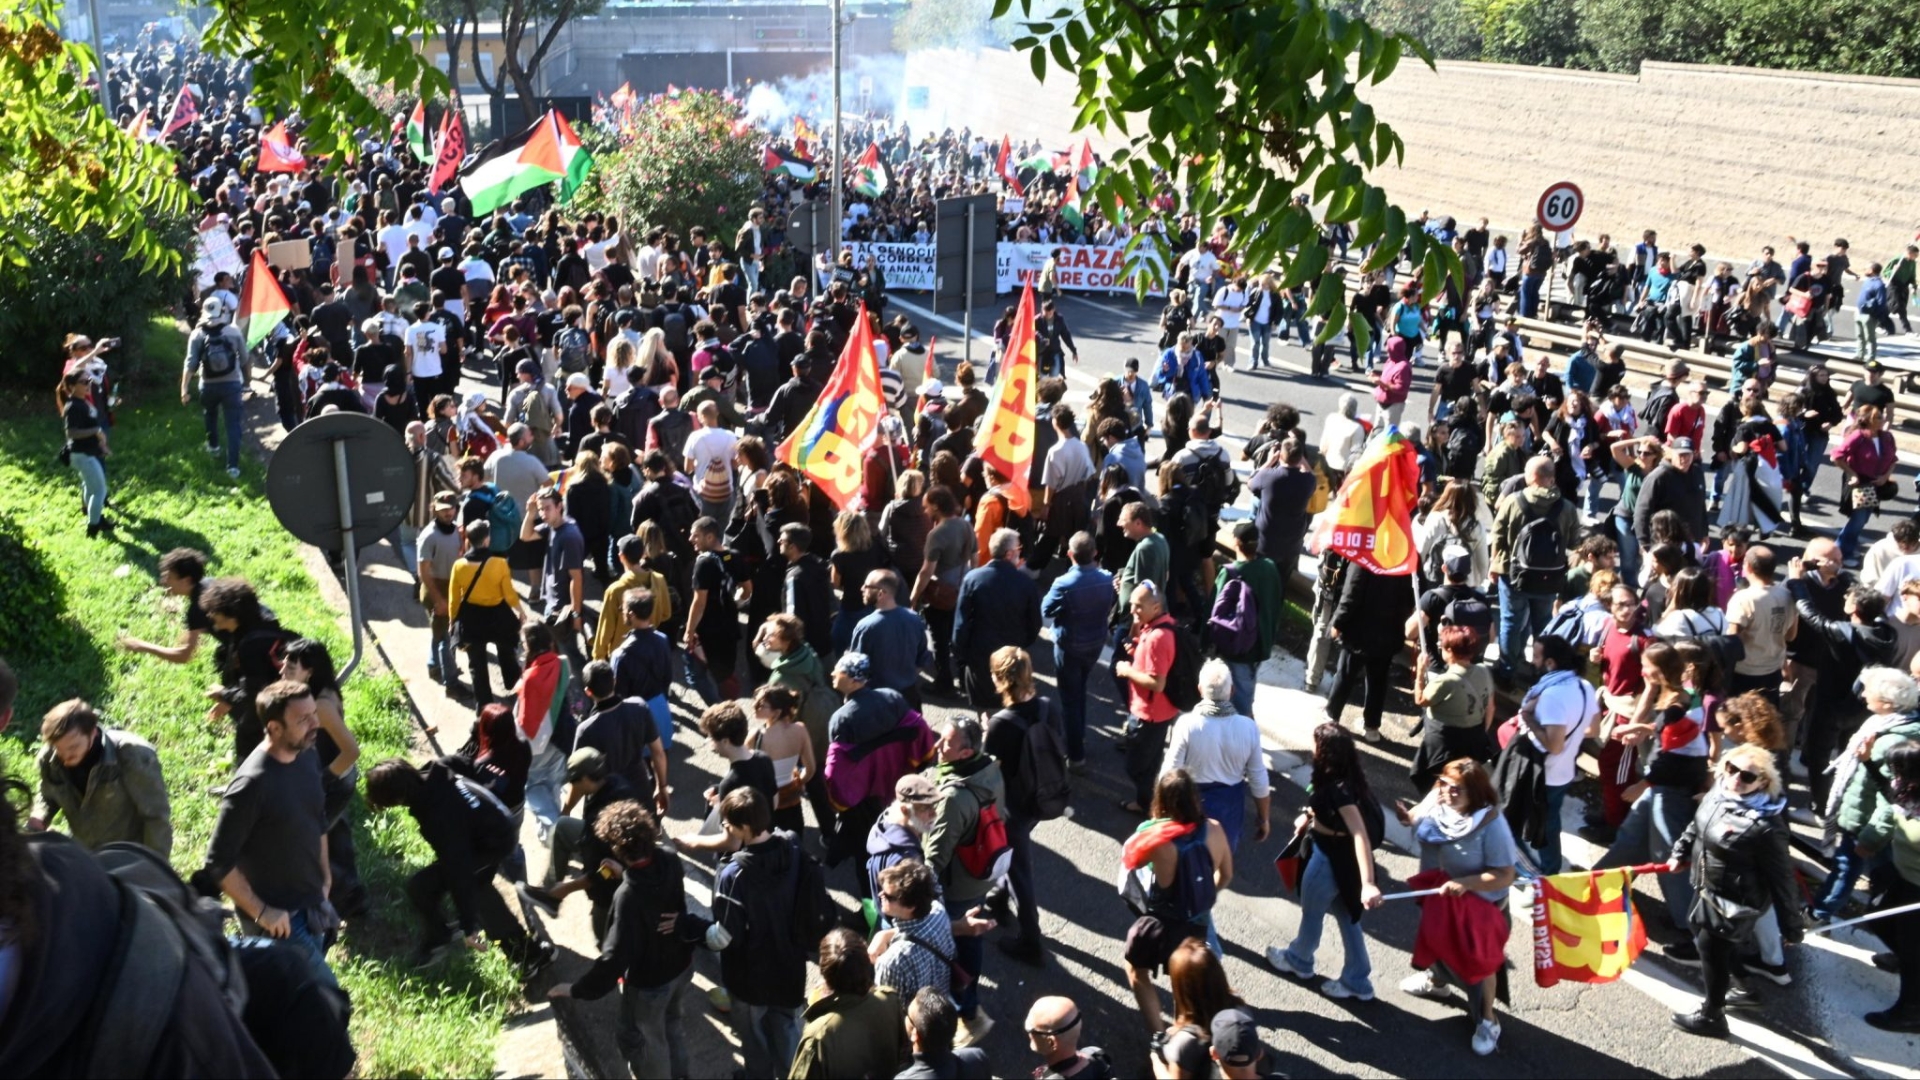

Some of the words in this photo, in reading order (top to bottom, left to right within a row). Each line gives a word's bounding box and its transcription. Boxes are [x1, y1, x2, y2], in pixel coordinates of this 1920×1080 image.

[1547, 195, 1574, 219] 60
[1055, 247, 1126, 270] GAZA
[1087, 272, 1161, 293] COMIG
